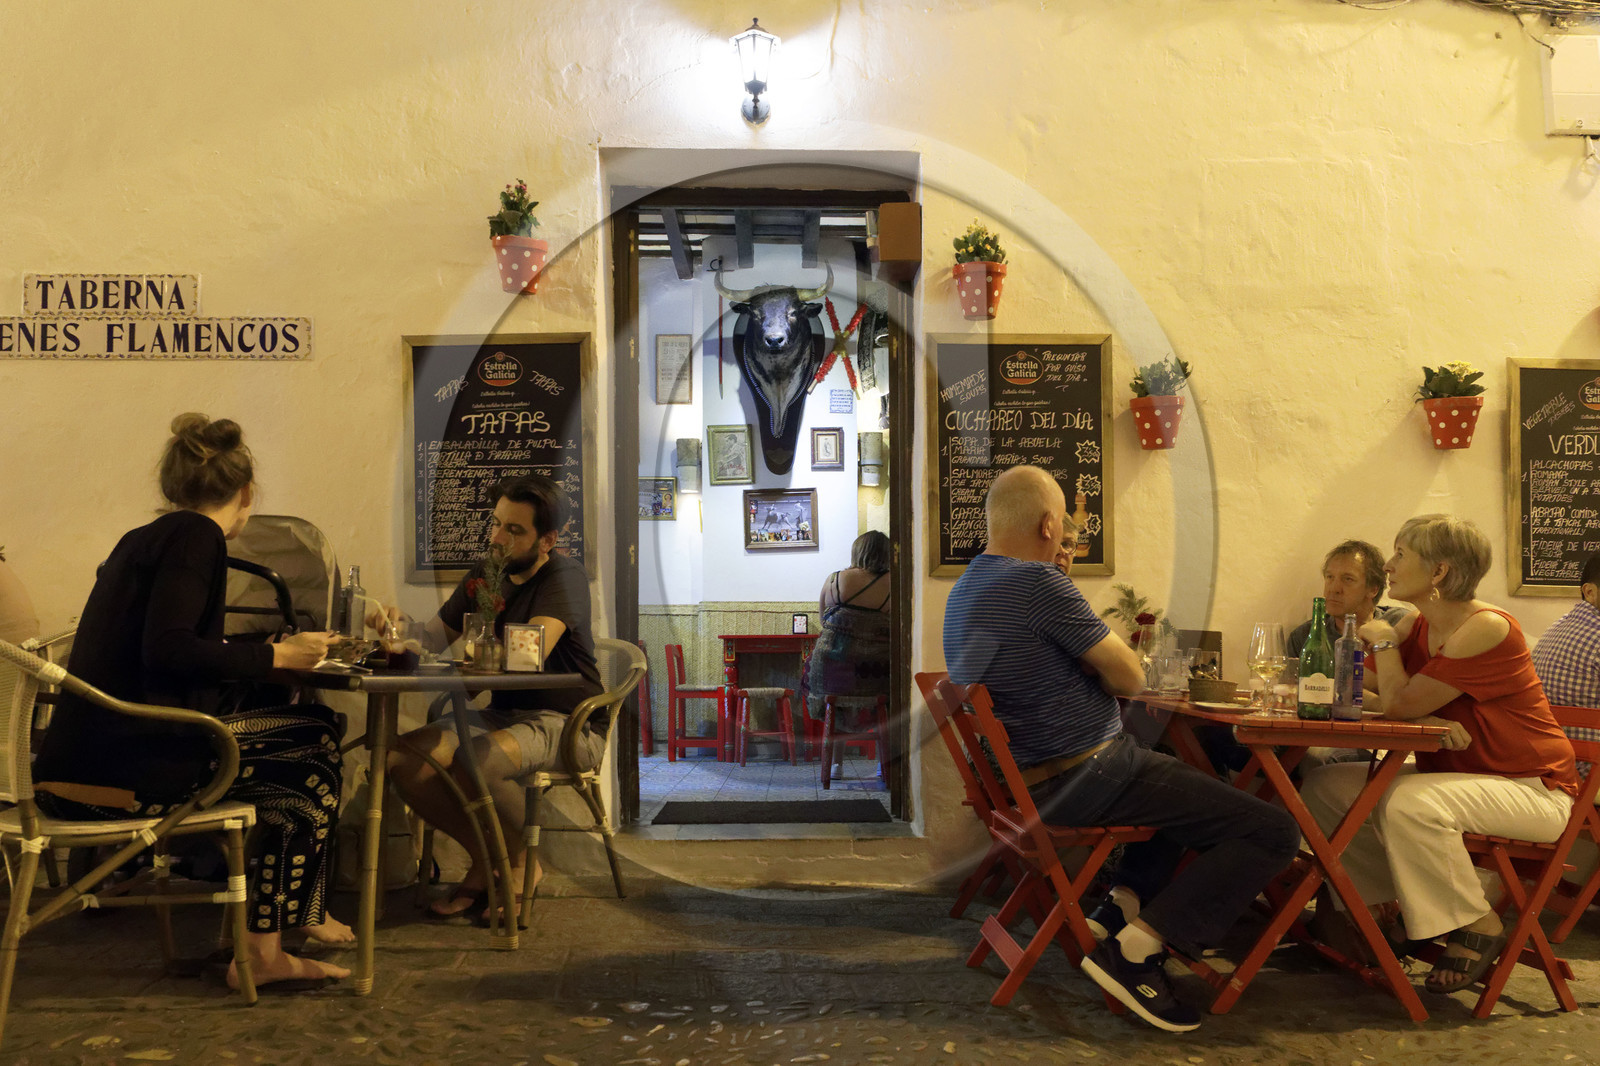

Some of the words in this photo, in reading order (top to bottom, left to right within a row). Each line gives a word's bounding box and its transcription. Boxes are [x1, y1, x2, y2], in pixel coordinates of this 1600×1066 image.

[36, 280, 186, 310] TABERNA
[106, 323, 300, 353] FLAMENCOS
[484, 361, 518, 371] Estrella
[1006, 360, 1039, 370] Estrella
[1044, 363, 1061, 373] POR
[485, 371, 516, 379] Galicia
[1007, 369, 1037, 378] Galicia
[434, 375, 469, 402] TAPAS
[529, 370, 565, 396] TAPAS
[940, 369, 987, 403] HOMEMADE
[959, 384, 987, 405] SOUPS
[1522, 392, 1567, 430] VEGETABLE
[461, 411, 550, 435] TAPAS
[945, 409, 1023, 432] CUCHAREO
[1030, 411, 1057, 430] DEL
[507, 440, 522, 449] DE
[525, 438, 557, 449] PULPO
[982, 437, 996, 447] DE
[1001, 437, 1015, 447] LA
[1018, 437, 1062, 448] ABUELA
[1532, 460, 1593, 471] ALCACHOFAS
[1566, 541, 1579, 551] DE
